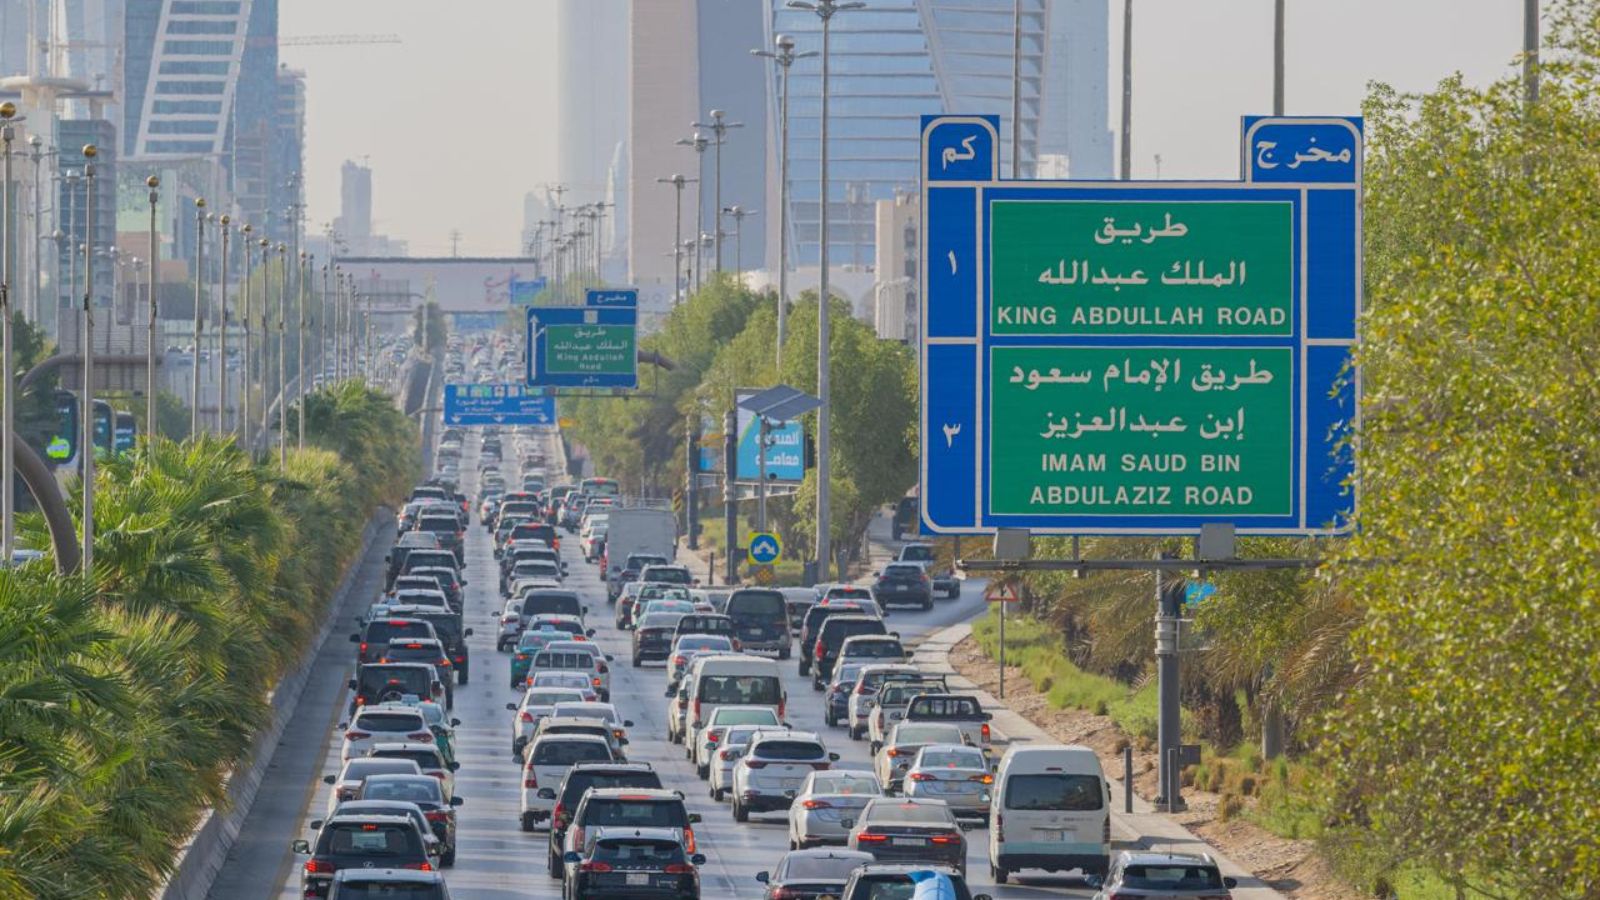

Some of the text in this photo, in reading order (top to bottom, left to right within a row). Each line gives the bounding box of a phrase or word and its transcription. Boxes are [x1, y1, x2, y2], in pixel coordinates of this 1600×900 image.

[942, 136, 976, 170] كم
[1257, 137, 1351, 169] مخرج
[1094, 213, 1188, 245] طريق
[948, 250, 957, 275] ١
[1161, 261, 1246, 288] الملك
[997, 307, 1286, 325] KING ABDULLAH ROAD
[1009, 359, 1274, 392] طريق الإمام سعود
[943, 423, 961, 447] ٣
[1199, 408, 1244, 440] إبن
[1041, 454, 1240, 472] IMAM SAUD BIN
[1030, 486, 1253, 505] ABDULAZIZ ROAD
